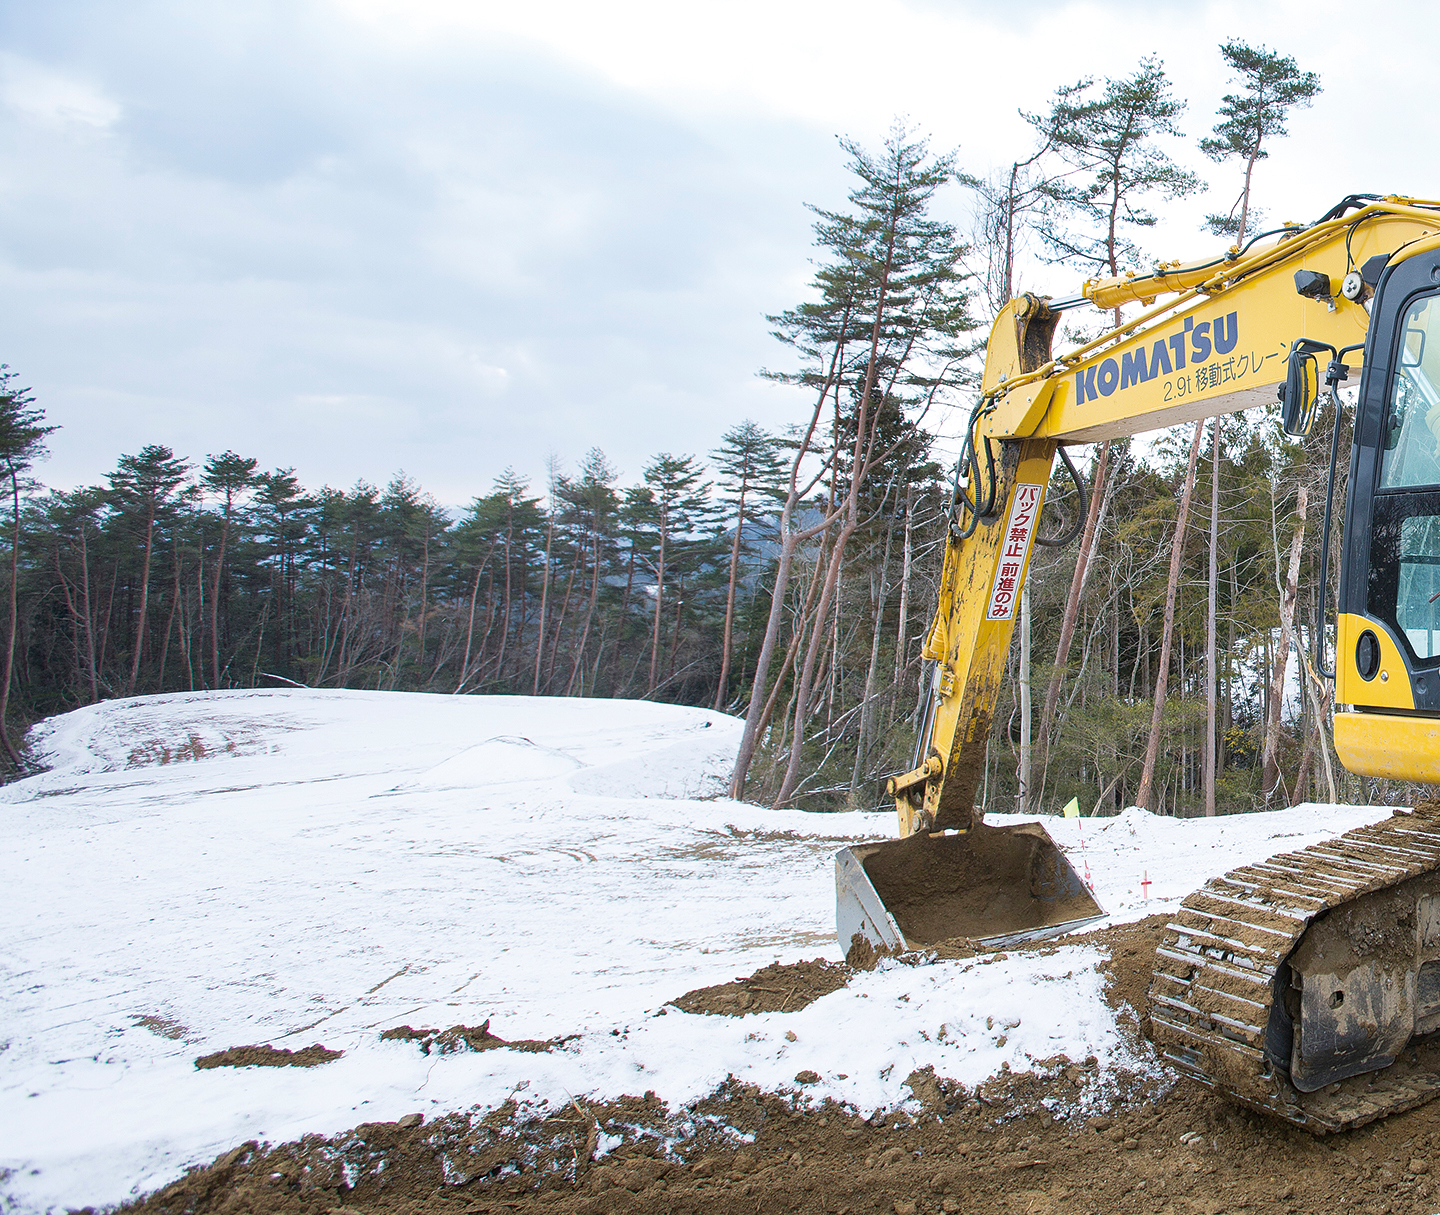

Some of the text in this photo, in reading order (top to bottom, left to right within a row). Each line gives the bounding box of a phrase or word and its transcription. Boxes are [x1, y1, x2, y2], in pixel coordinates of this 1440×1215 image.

[1075, 311, 1239, 406] KOMATSU
[1163, 341, 1293, 402] 2.9t 移動式クレーン
[991, 487, 1039, 617] バック禁止 前進のみ
